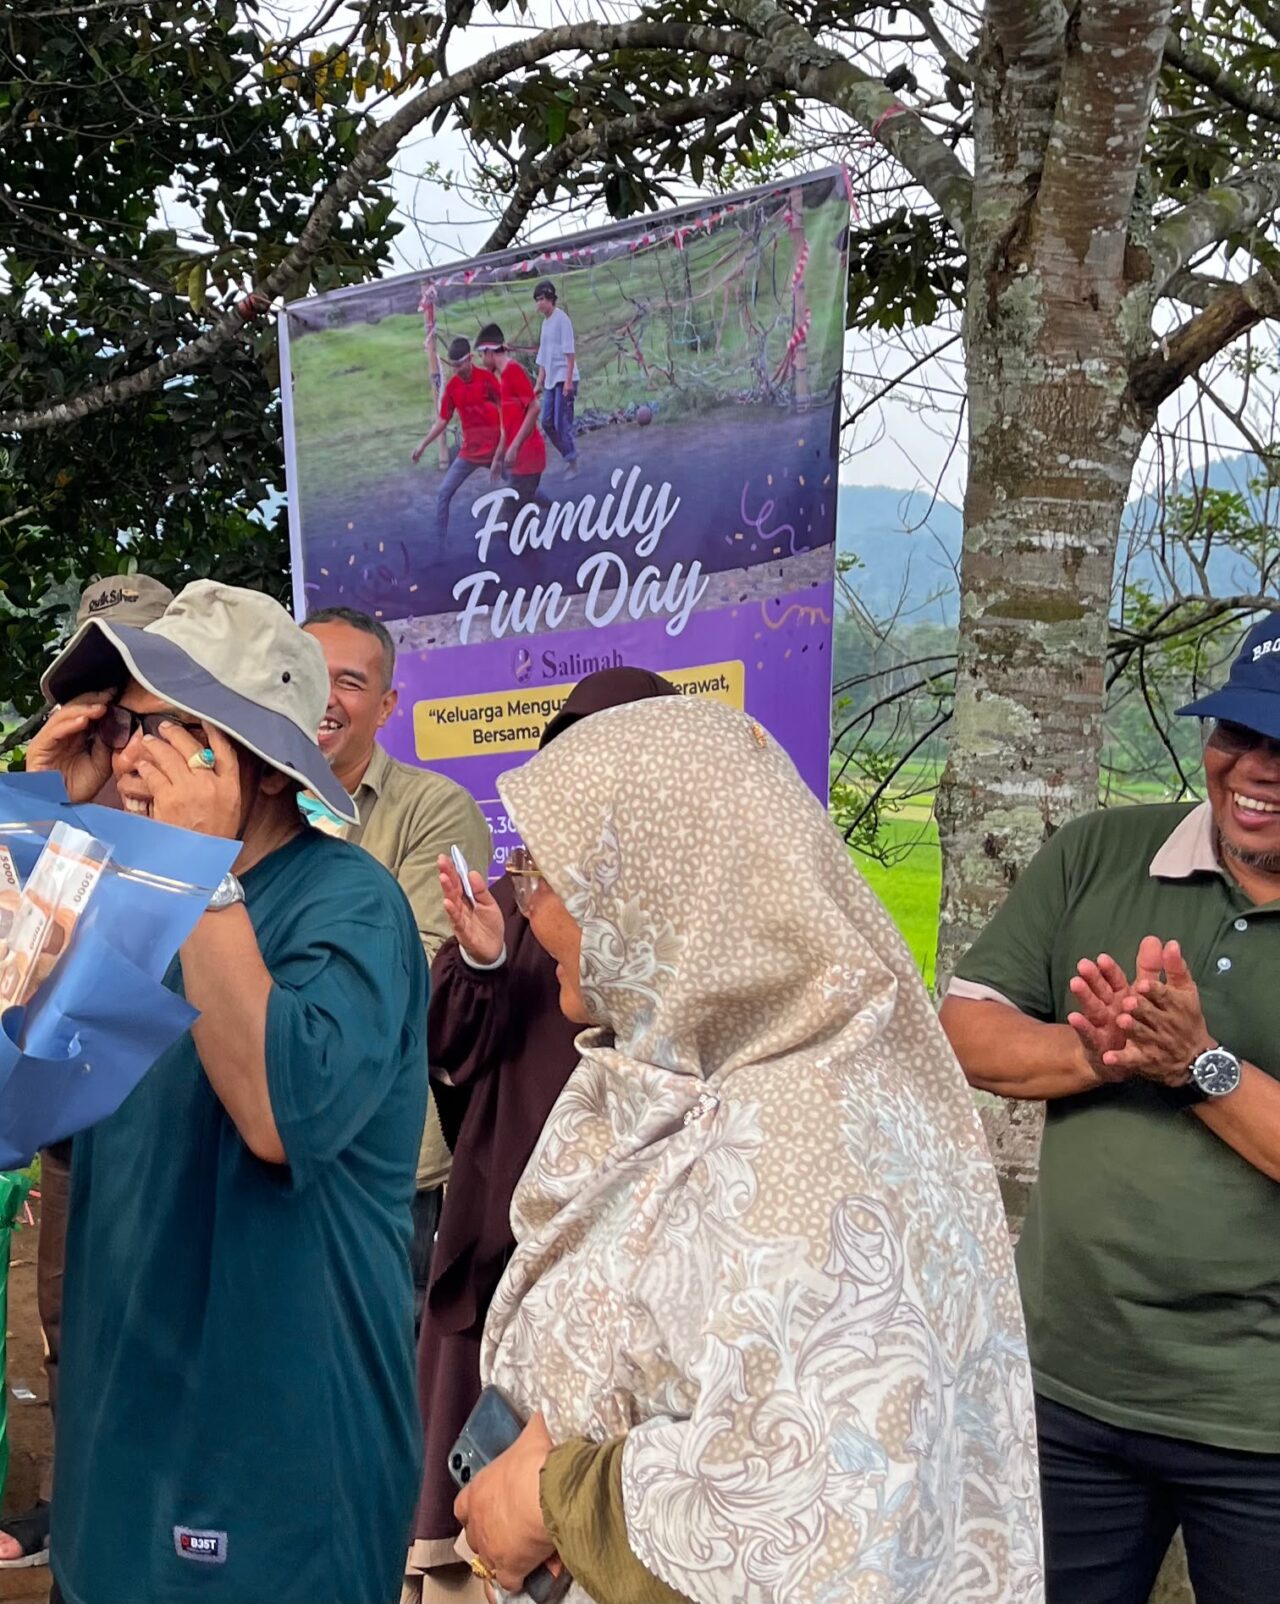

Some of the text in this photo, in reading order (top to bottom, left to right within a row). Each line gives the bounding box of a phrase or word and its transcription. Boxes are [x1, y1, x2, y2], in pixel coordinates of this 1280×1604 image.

[471, 465, 681, 564] Family
[452, 551, 710, 645] Fun Day
[541, 649, 624, 679] Salimah
[428, 704, 503, 725] “Keluarga
[472, 724, 540, 744] Bersama
